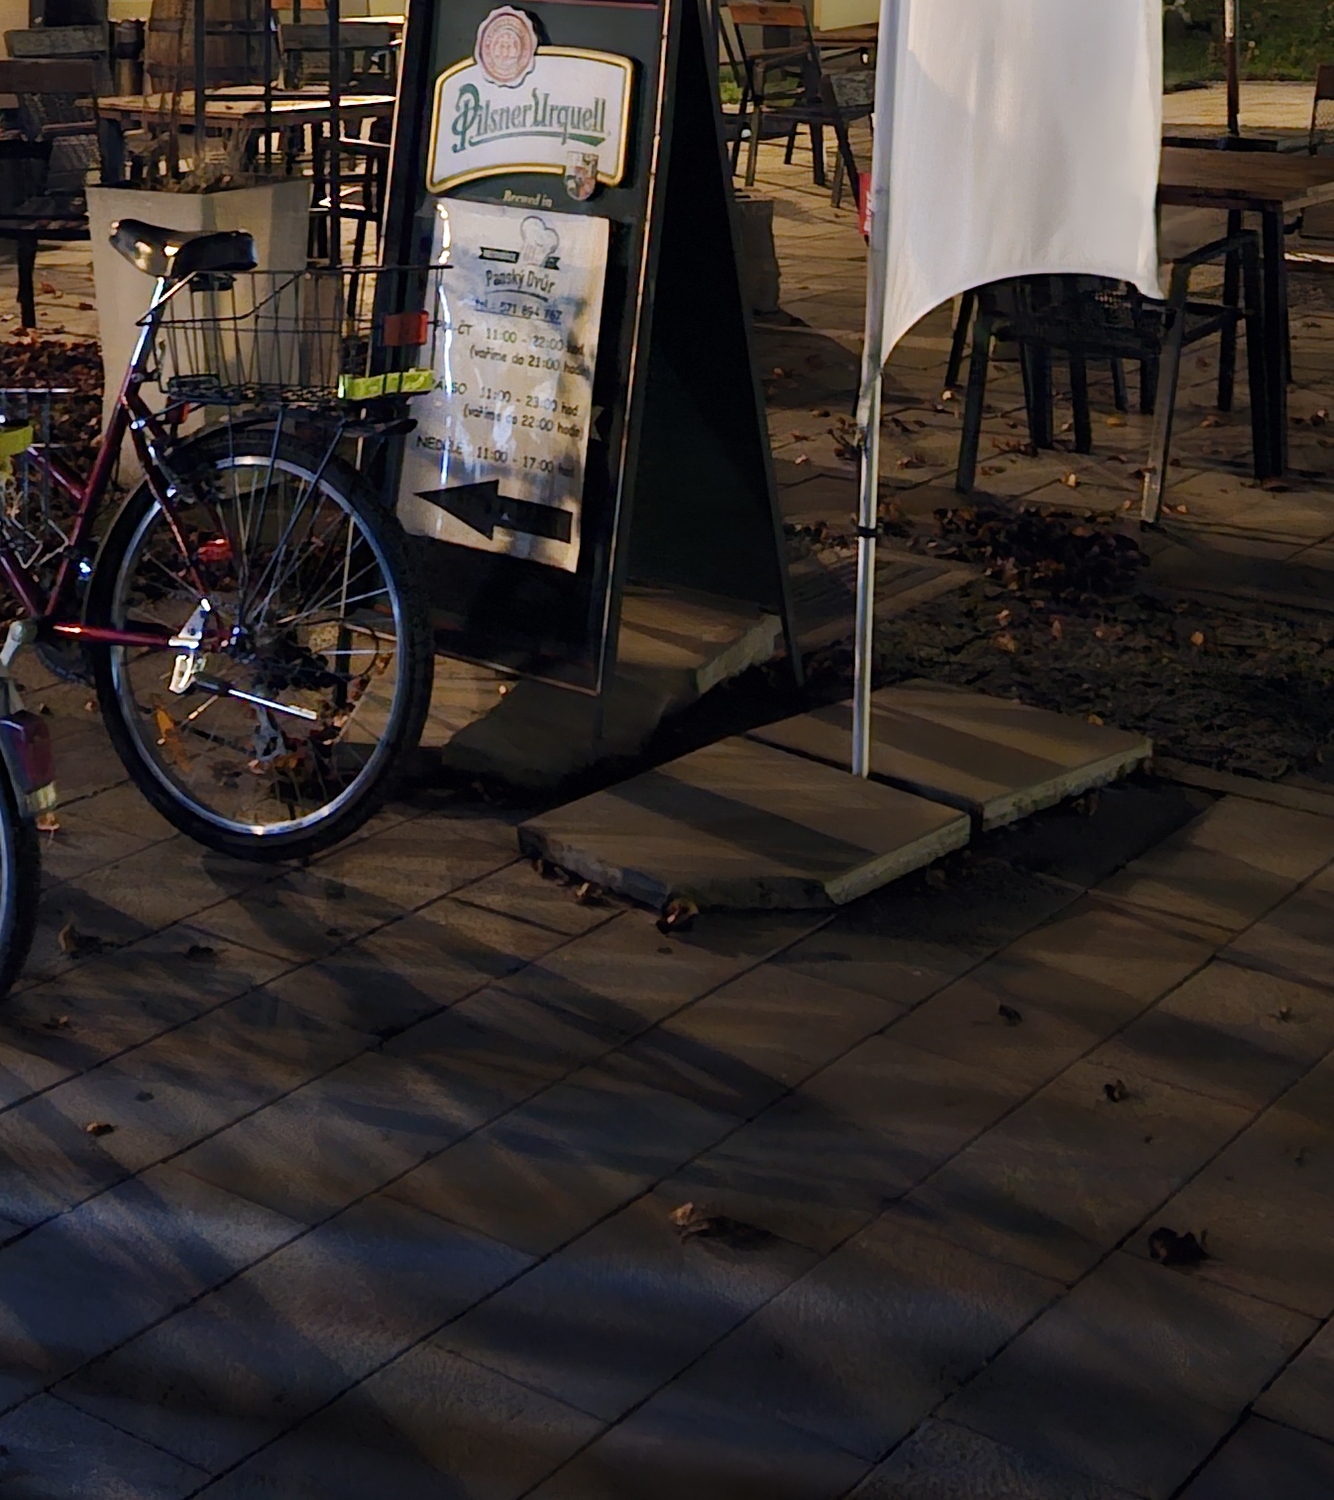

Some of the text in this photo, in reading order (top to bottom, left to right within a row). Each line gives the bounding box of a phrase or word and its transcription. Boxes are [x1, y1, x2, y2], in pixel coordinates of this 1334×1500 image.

[451, 83, 607, 154] Pilsner Urquell
[485, 268, 524, 289] Panský
[485, 327, 518, 344] 11:00
[532, 334, 564, 352] 22:00
[511, 352, 525, 367] do
[528, 354, 561, 372] 21:00
[521, 414, 554, 432] 22:00
[417, 435, 463, 455] NEDLE
[476, 445, 508, 463] 11:00
[522, 455, 554, 474] 17:00
